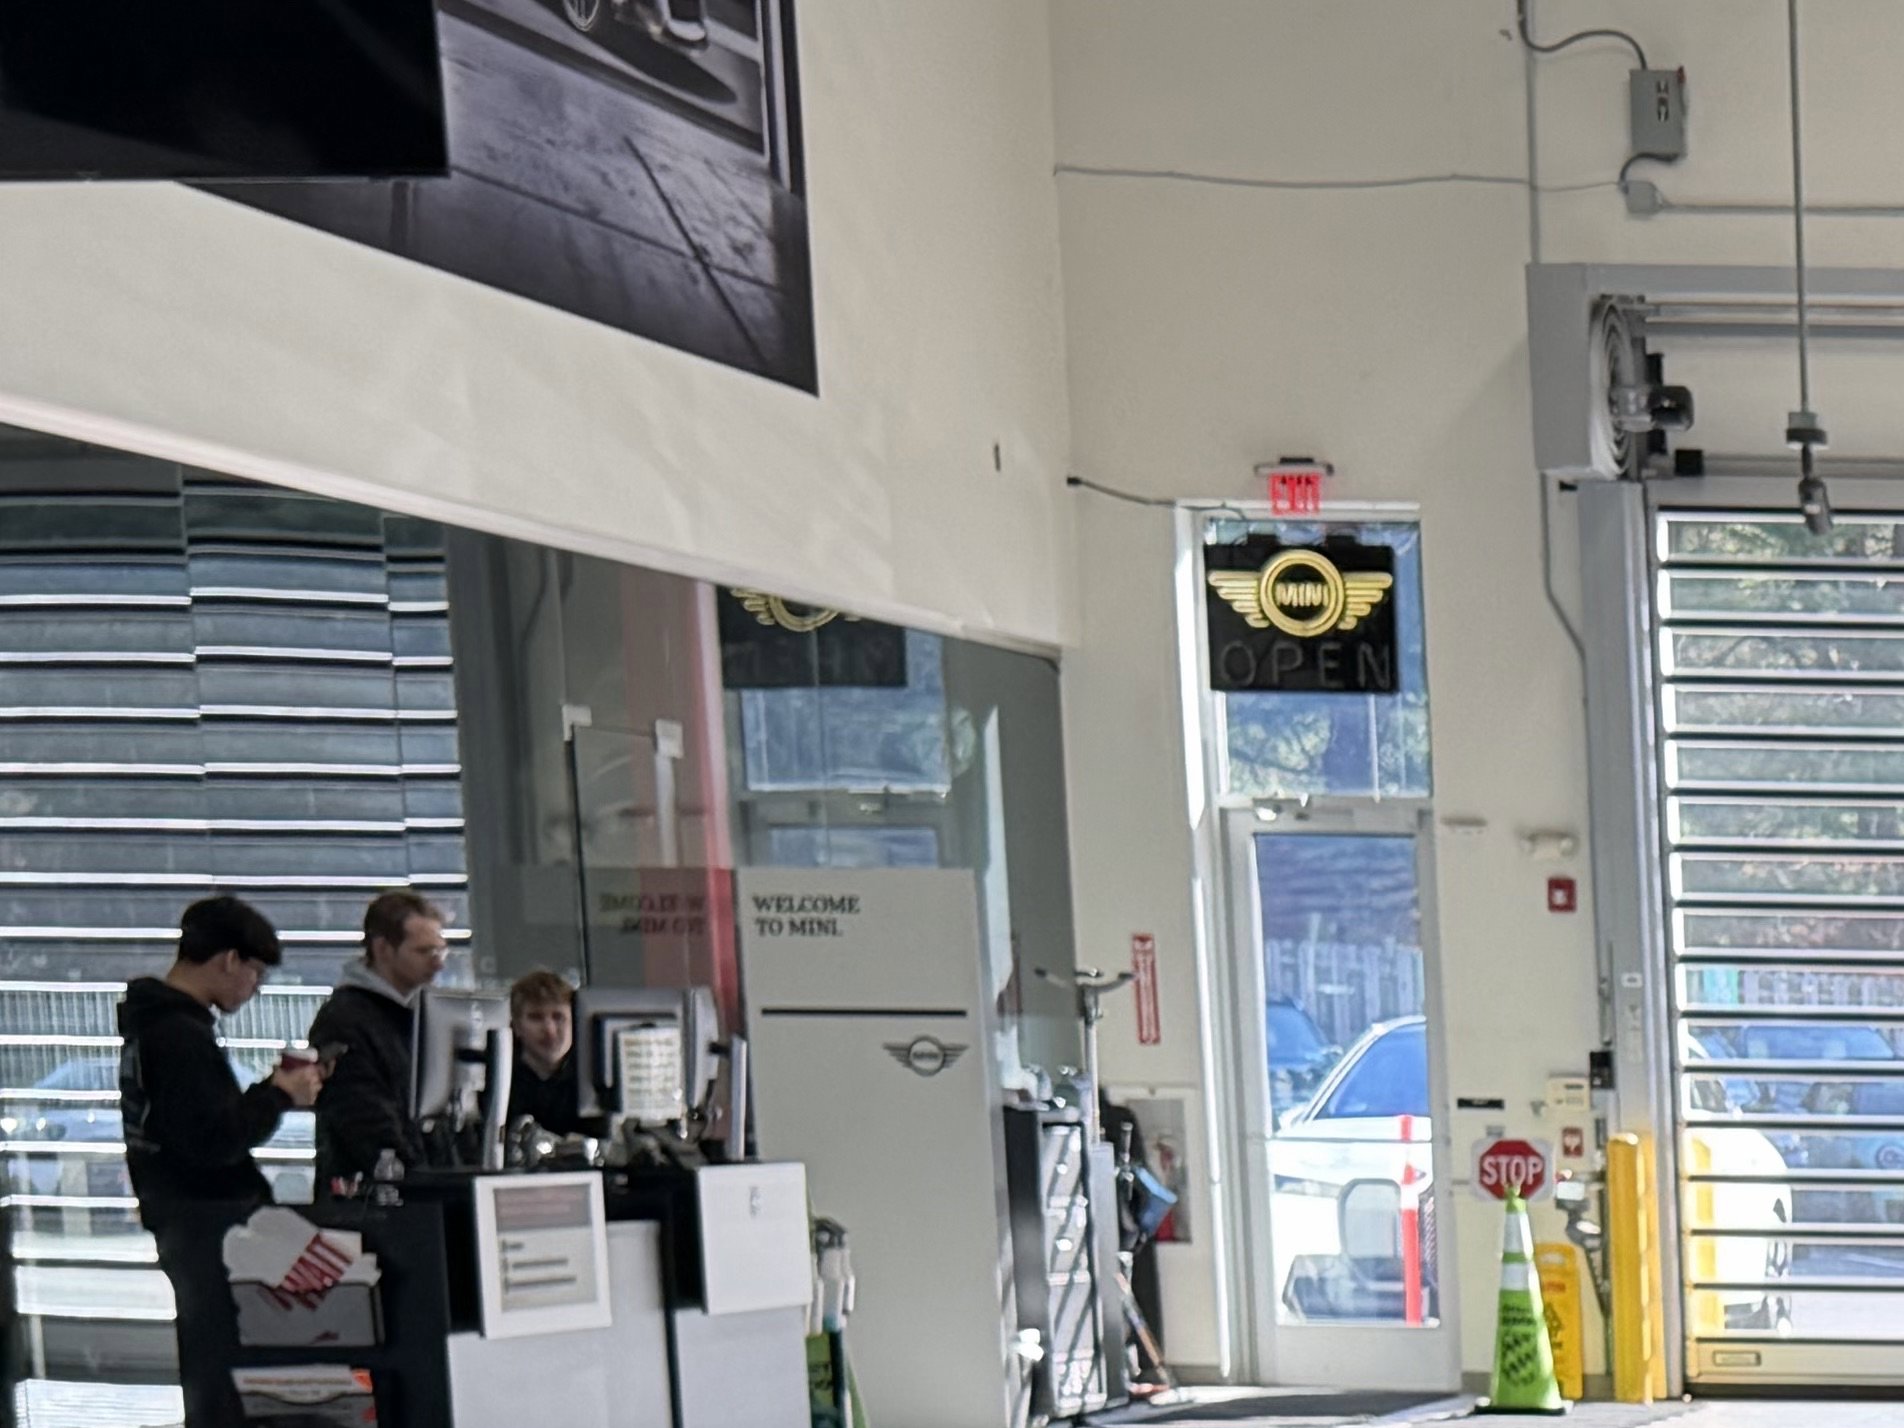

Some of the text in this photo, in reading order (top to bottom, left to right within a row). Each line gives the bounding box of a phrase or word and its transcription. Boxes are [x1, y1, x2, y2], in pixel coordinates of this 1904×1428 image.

[1269, 474, 1320, 515] EXIT
[1276, 582, 1329, 607] MINI
[1221, 640, 1391, 689] OPEN
[752, 895, 860, 914] WELCOME
[756, 917, 784, 936] TO
[1482, 1155, 1544, 1185] STOP
